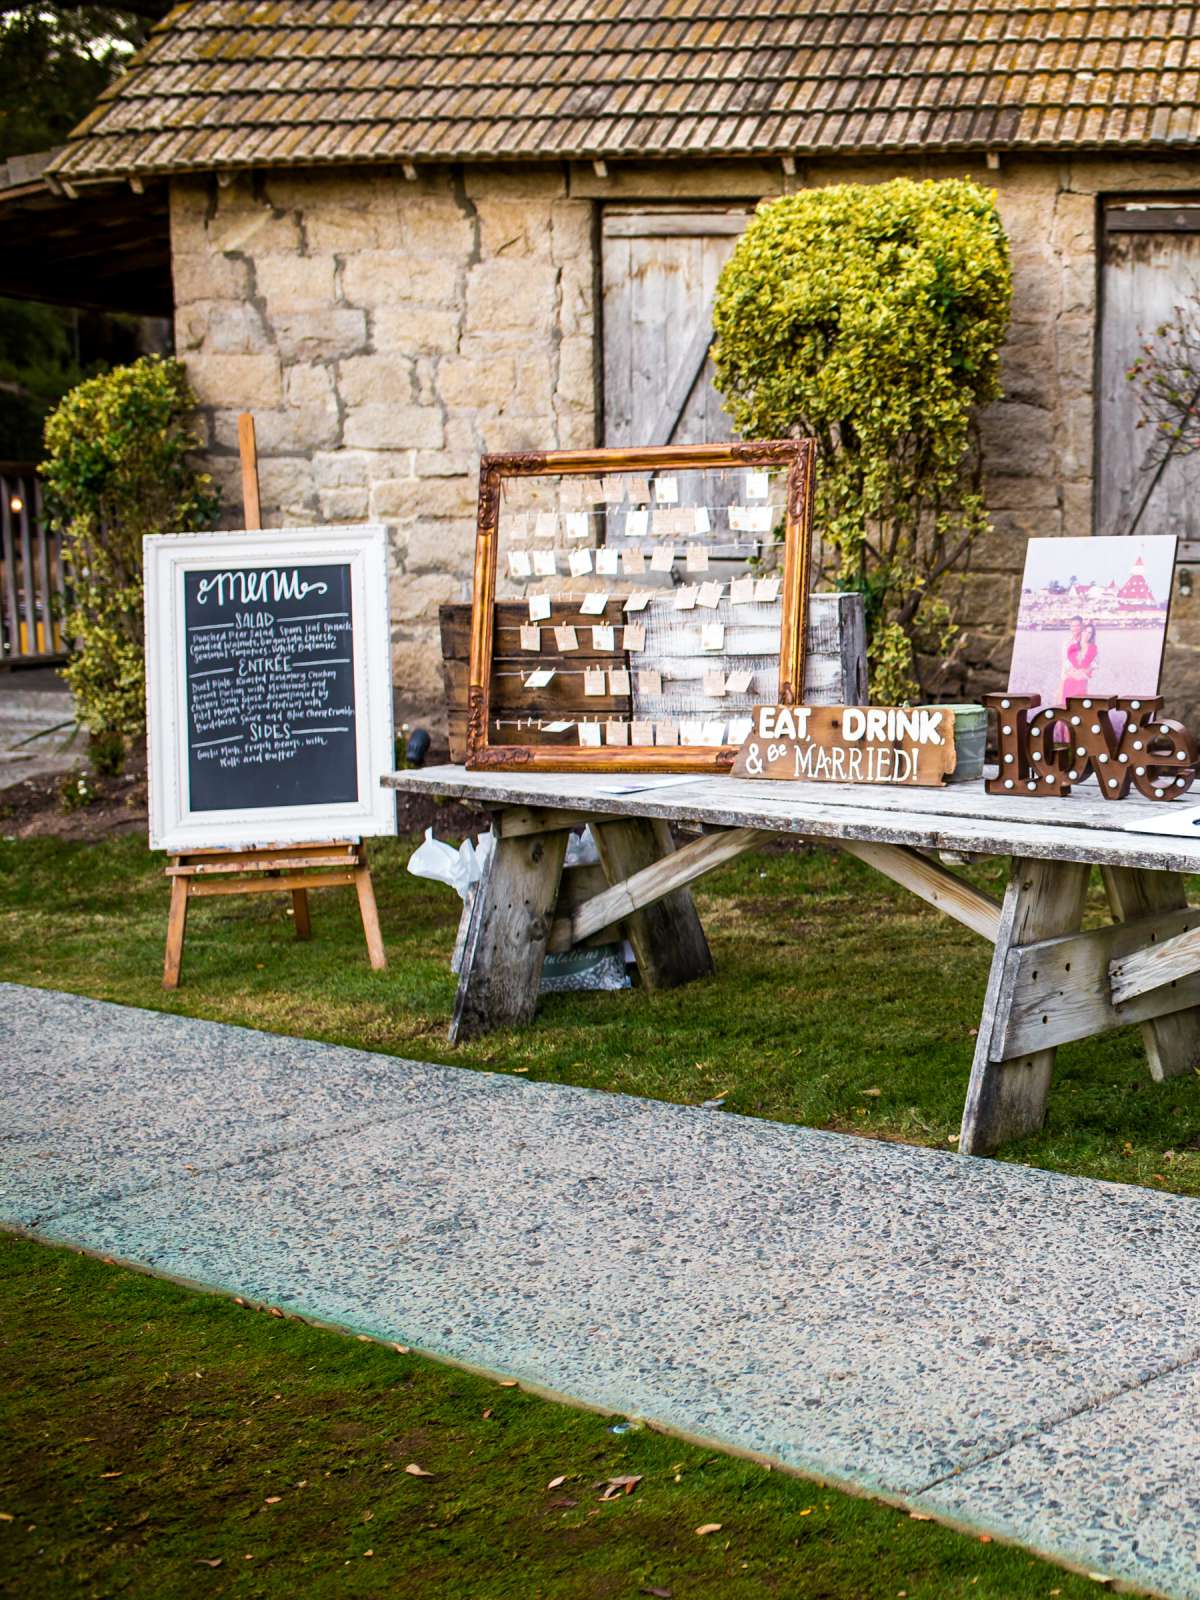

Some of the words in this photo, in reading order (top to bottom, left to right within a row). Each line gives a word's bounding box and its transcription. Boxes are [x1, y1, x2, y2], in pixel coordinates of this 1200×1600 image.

[197, 569, 328, 606] menu
[235, 612, 274, 629] SALAD
[190, 641, 222, 656] Candied
[236, 673, 266, 685] Roasted
[247, 683, 266, 694] with
[250, 722, 290, 741] SIDES
[759, 706, 812, 741] EAT,
[842, 708, 945, 745] DRINK,
[745, 743, 763, 775] &
[793, 743, 920, 782] MARRIED!
